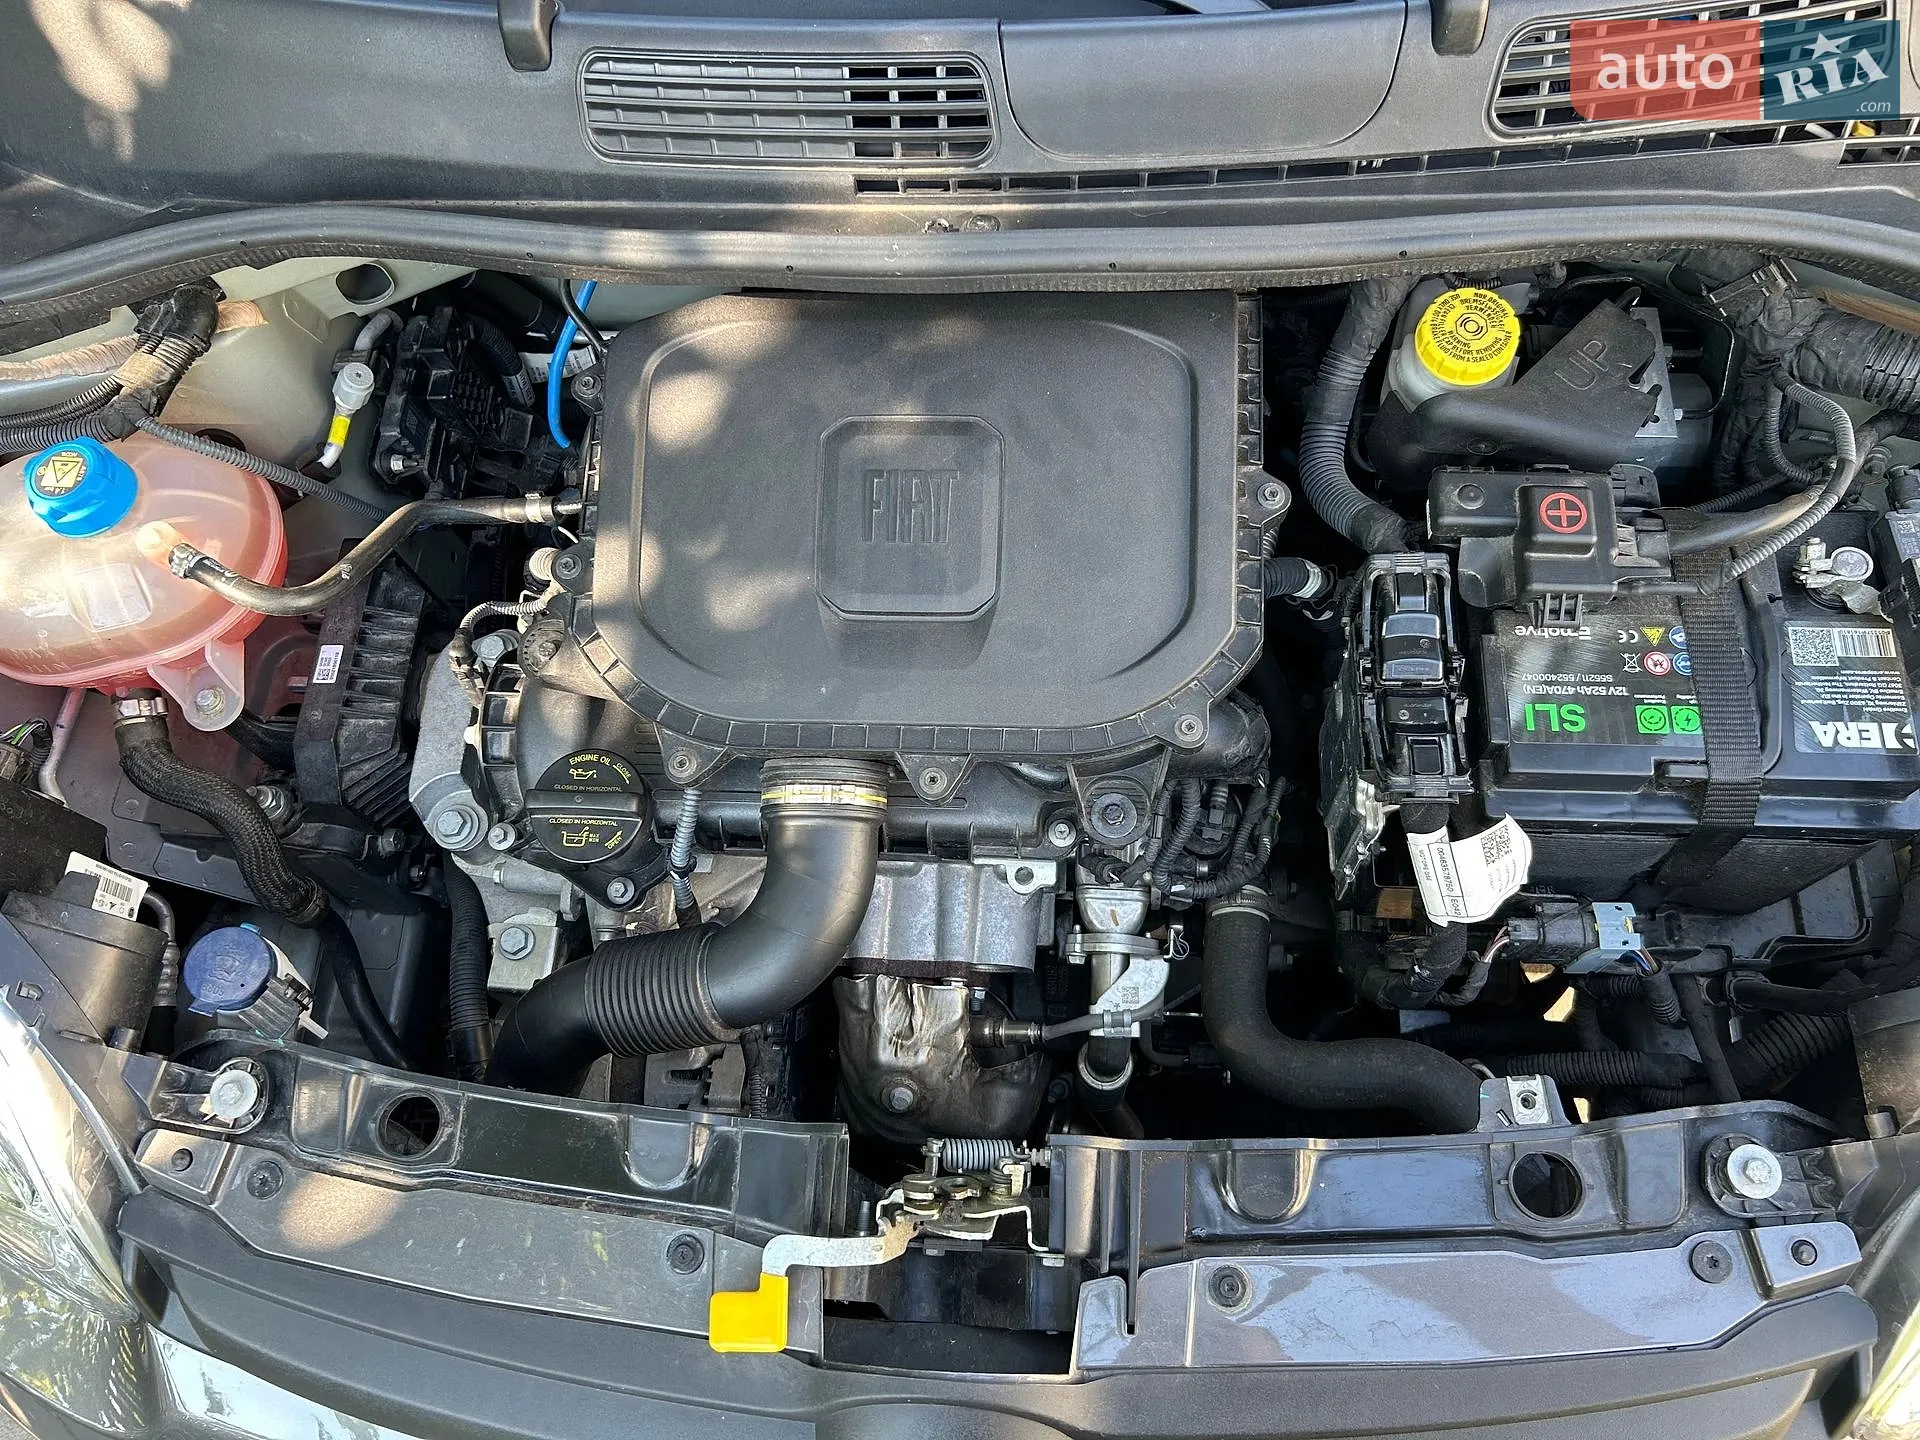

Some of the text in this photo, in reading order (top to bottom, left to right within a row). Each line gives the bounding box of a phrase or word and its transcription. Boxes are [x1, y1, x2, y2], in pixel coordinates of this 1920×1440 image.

[1487, 296, 1509, 319] ORIGINAL
[1437, 303, 1502, 355] CLEAN FILLER CAP BEFORE REMOVING
[1436, 339, 1450, 354] FLUID
[1449, 352, 1465, 361] FROM
[1471, 353, 1494, 363] SEALED
[1493, 331, 1513, 356] CONTAINER
[1447, 330, 1471, 349] WARNING
[1553, 338, 1608, 390] UP
[861, 469, 960, 544] FIAT
[1521, 673, 1575, 681] 552400047
[1582, 675, 1613, 683] S55211
[1523, 684, 1629, 696] 12V 52Ah 470A(EN)
[1524, 703, 1586, 732] SLI
[569, 754, 611, 766] ENGINE OIL
[616, 762, 632, 778] CLOSE
[554, 783, 578, 791] CLOSED
[581, 819, 618, 827] HORIZONTAL
[608, 836, 623, 850] OPEN
[1450, 898, 1461, 916] E042
